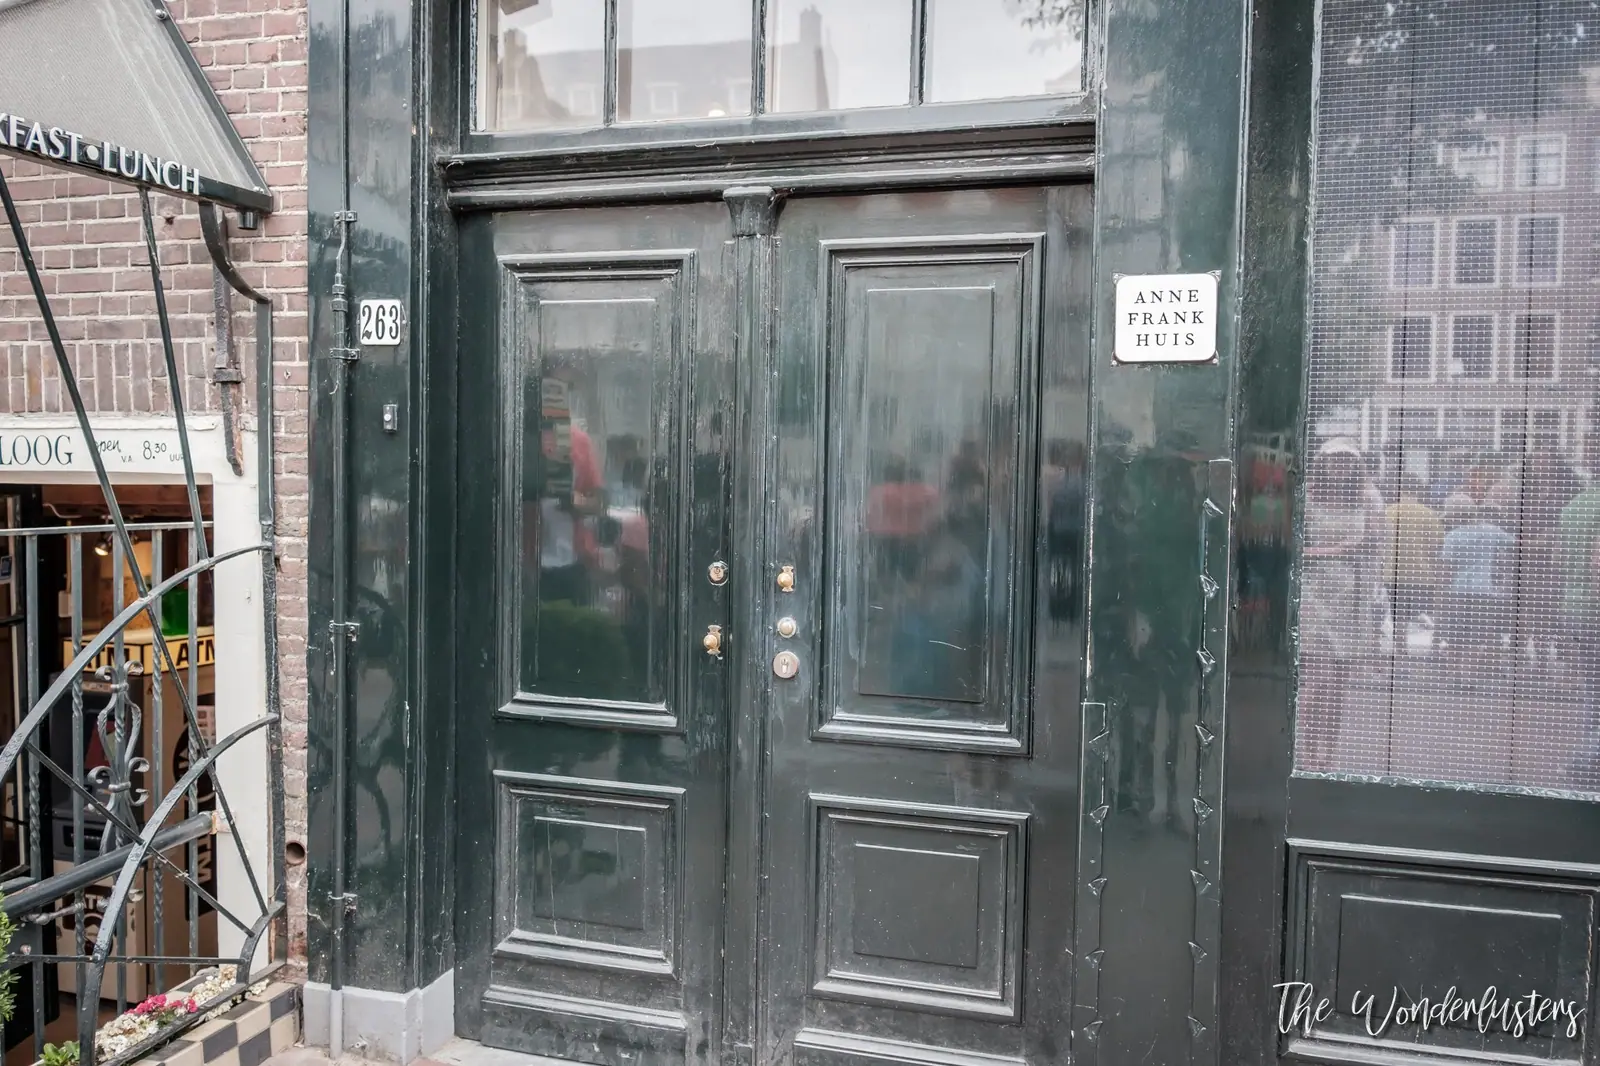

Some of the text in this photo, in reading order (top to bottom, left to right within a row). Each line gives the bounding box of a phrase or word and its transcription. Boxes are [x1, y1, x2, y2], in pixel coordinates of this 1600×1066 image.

[102, 141, 200, 195] LUNCH
[1134, 289, 1199, 304] ANNE
[361, 304, 399, 340] 263
[1128, 311, 1204, 325] FRANK
[1136, 333, 1195, 346] HUIS
[0, 434, 73, 466] LOOG
[95, 440, 121, 454] pen
[143, 440, 167, 460] 8.30
